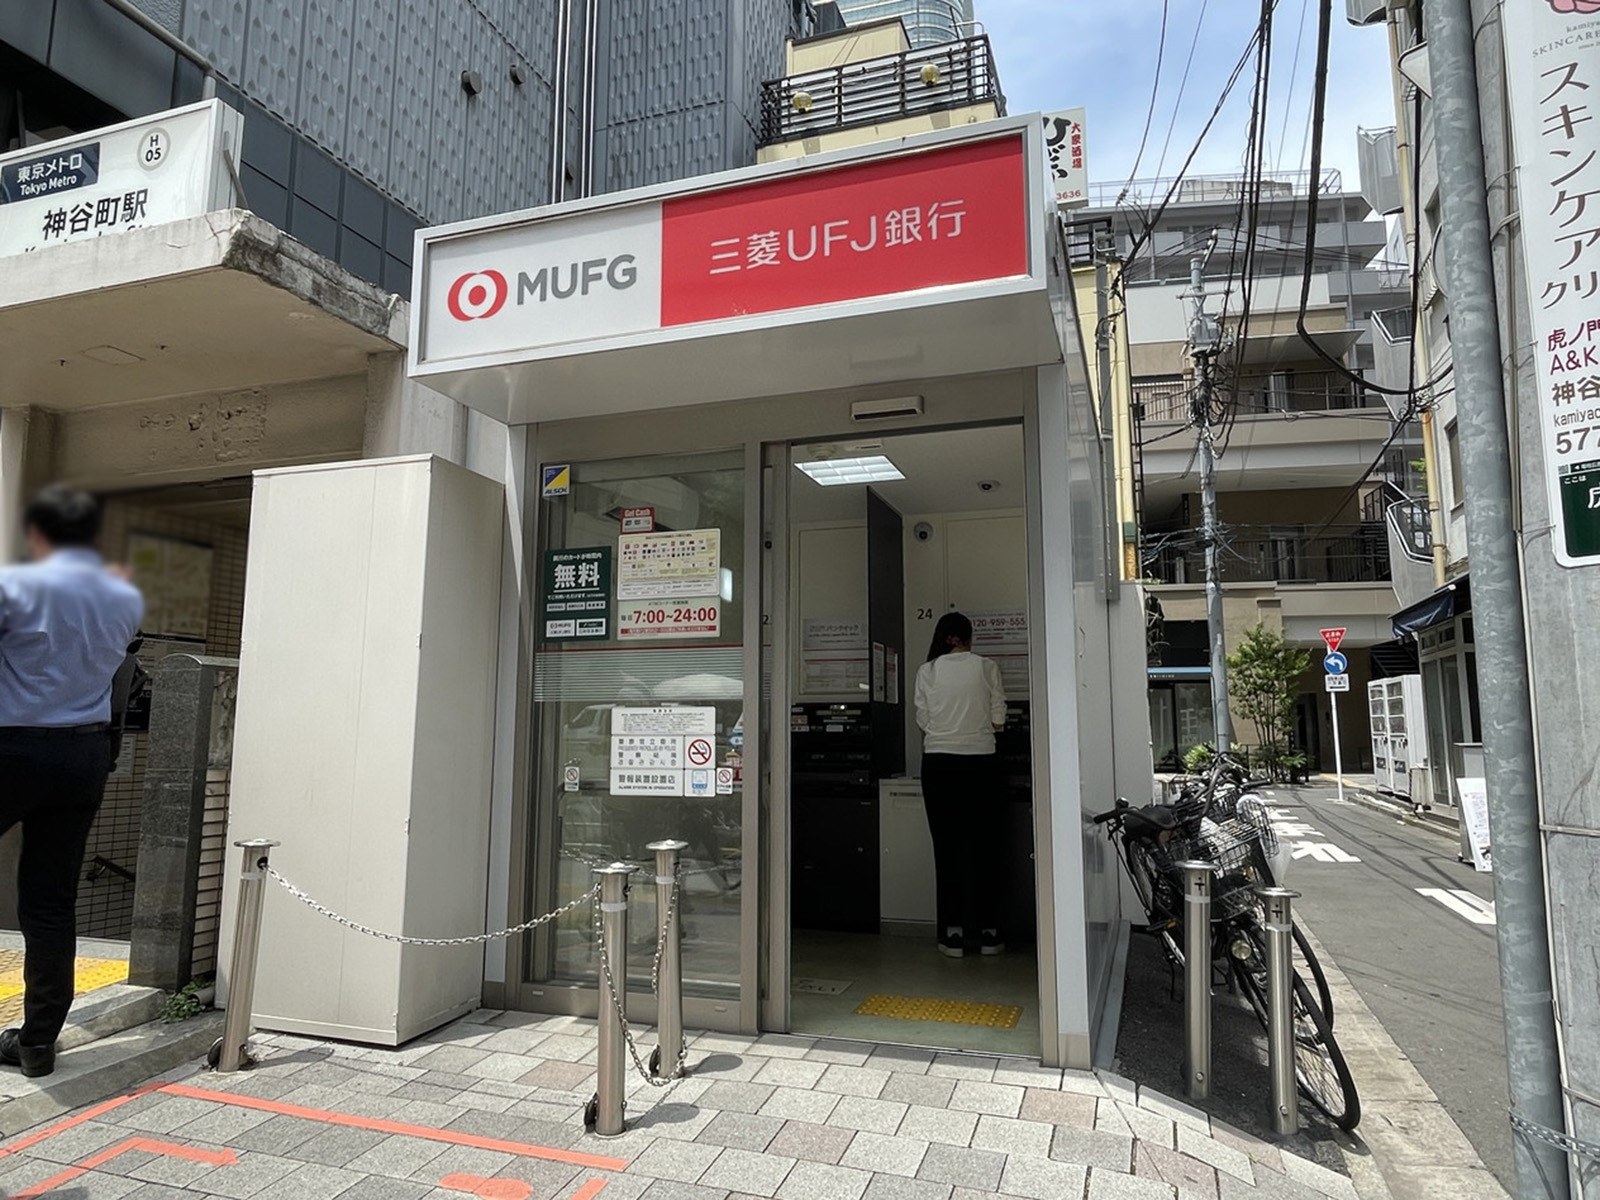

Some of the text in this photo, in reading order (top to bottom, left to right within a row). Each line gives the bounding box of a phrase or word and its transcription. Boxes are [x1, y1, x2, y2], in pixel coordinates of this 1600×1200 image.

[145, 147, 162, 163] 05
[150, 135, 159, 148] H
[1071, 122, 1082, 169] 大衆酒場
[17, 153, 82, 183] 東京メトロ
[1539, 61, 1600, 271] スキンケア
[20, 174, 77, 196] Tokyo Metro
[42, 188, 148, 241] 神谷町駅
[709, 199, 967, 277] 三菱UFJ銀行
[517, 253, 637, 306] MUFG
[1550, 345, 1599, 375] A&K
[1552, 375, 1600, 407] 神谷
[1564, 475, 1587, 485] ここは
[553, 561, 600, 589] 無料
[917, 608, 933, 620] 24
[972, 616, 1026, 627] 120-959-555
